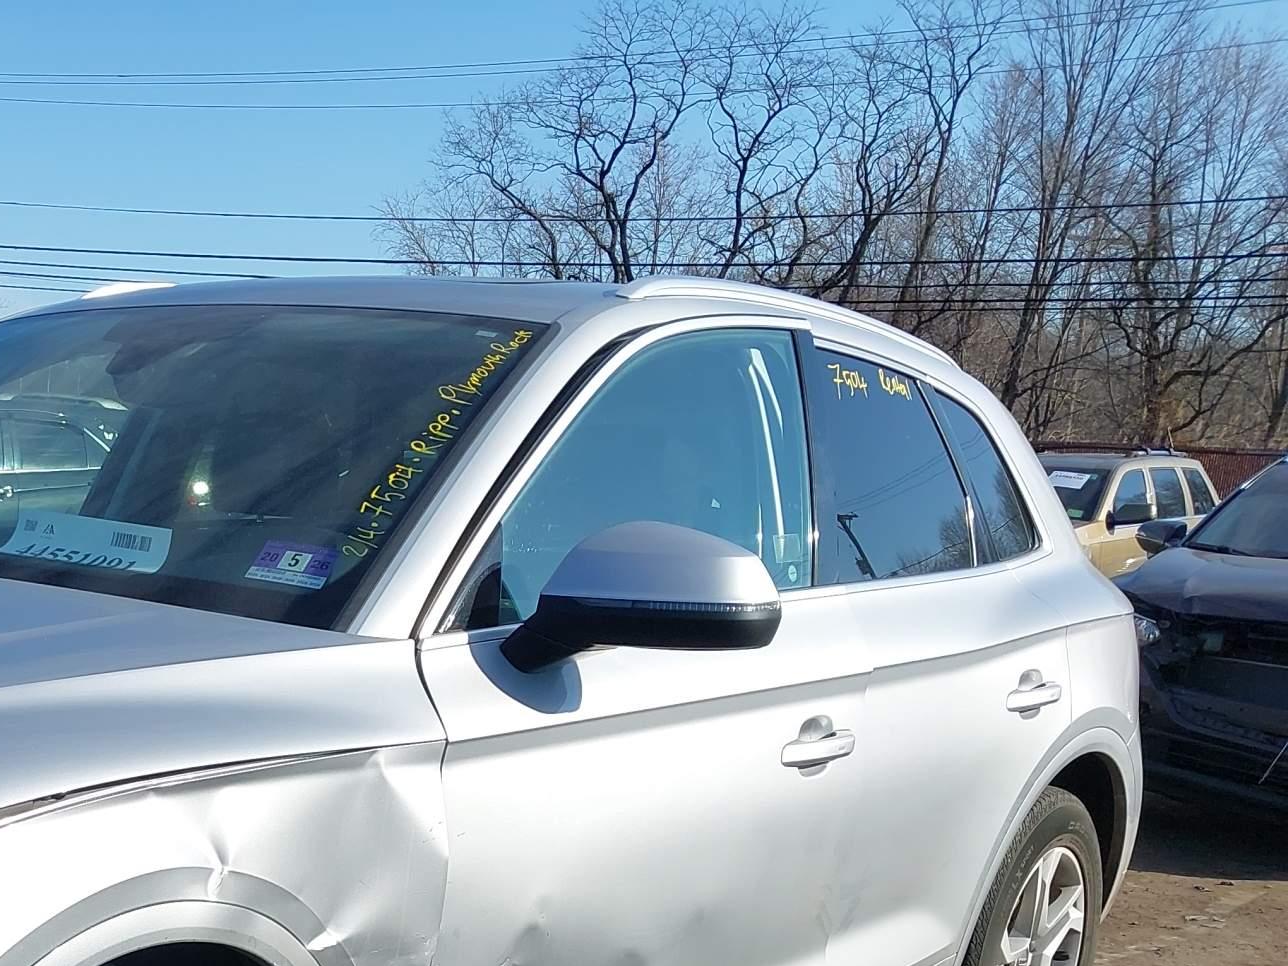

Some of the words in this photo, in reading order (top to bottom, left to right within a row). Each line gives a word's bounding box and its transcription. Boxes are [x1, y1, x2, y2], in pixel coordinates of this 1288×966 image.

[827, 363, 868, 400] 7504
[261, 552, 279, 562] 20
[288, 553, 303, 568] 5
[311, 560, 330, 570] 26
